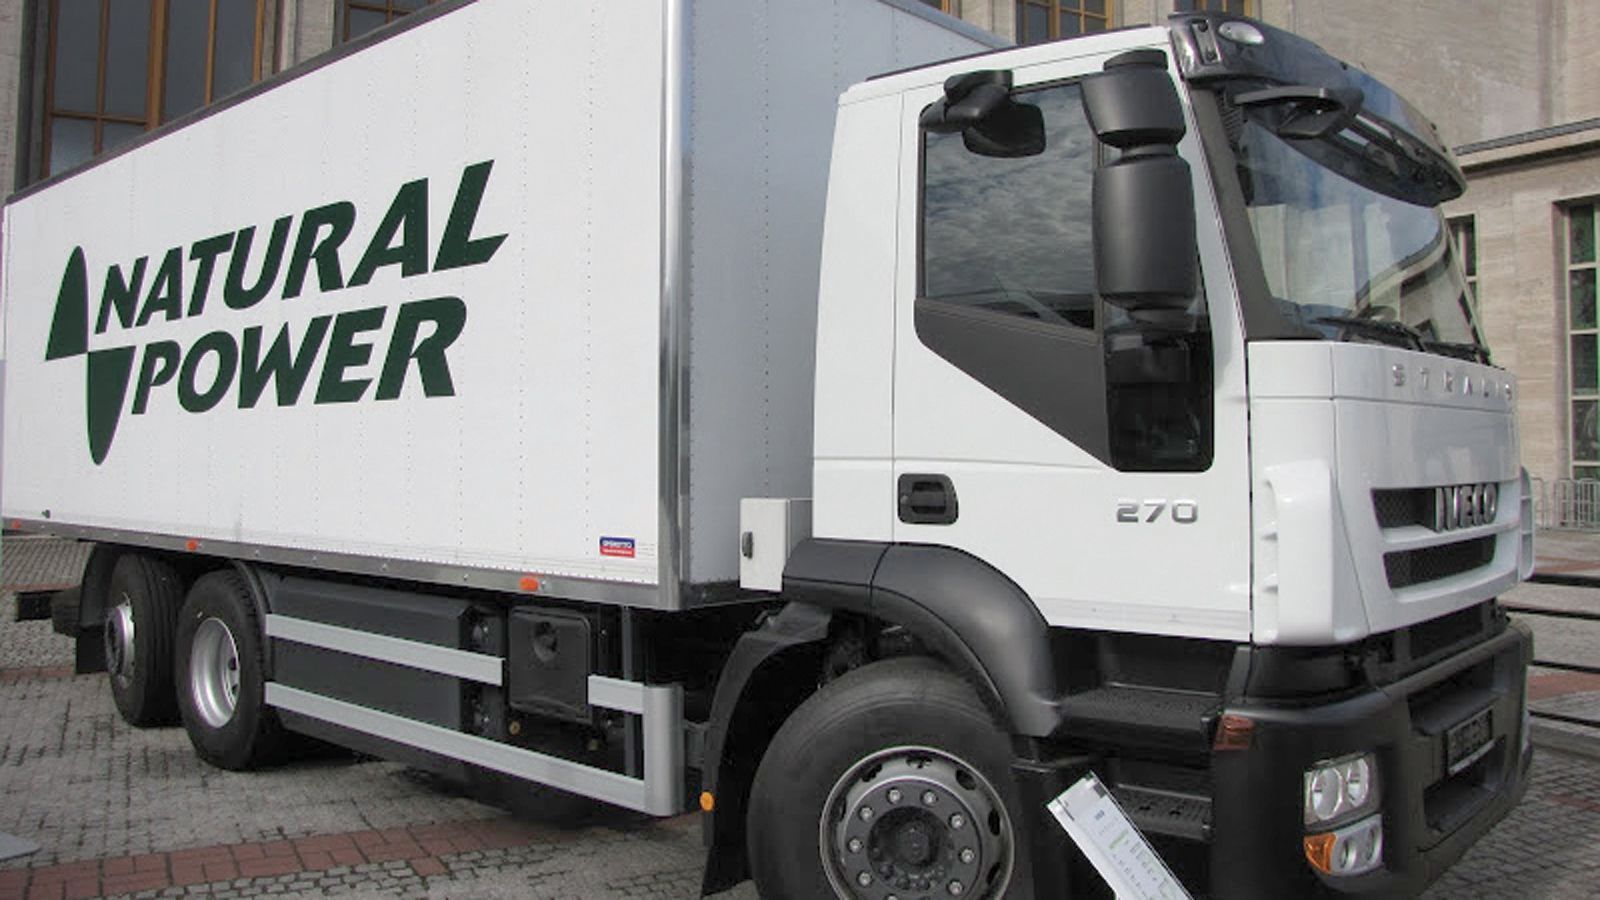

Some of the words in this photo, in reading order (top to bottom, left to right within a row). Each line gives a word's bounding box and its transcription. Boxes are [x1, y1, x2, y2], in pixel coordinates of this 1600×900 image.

[95, 159, 509, 335] NATURAL
[131, 296, 467, 415] POWER
[1392, 363, 1514, 401] STRALIS
[1116, 498, 1199, 524] 270
[1434, 483, 1498, 534] IVECO
